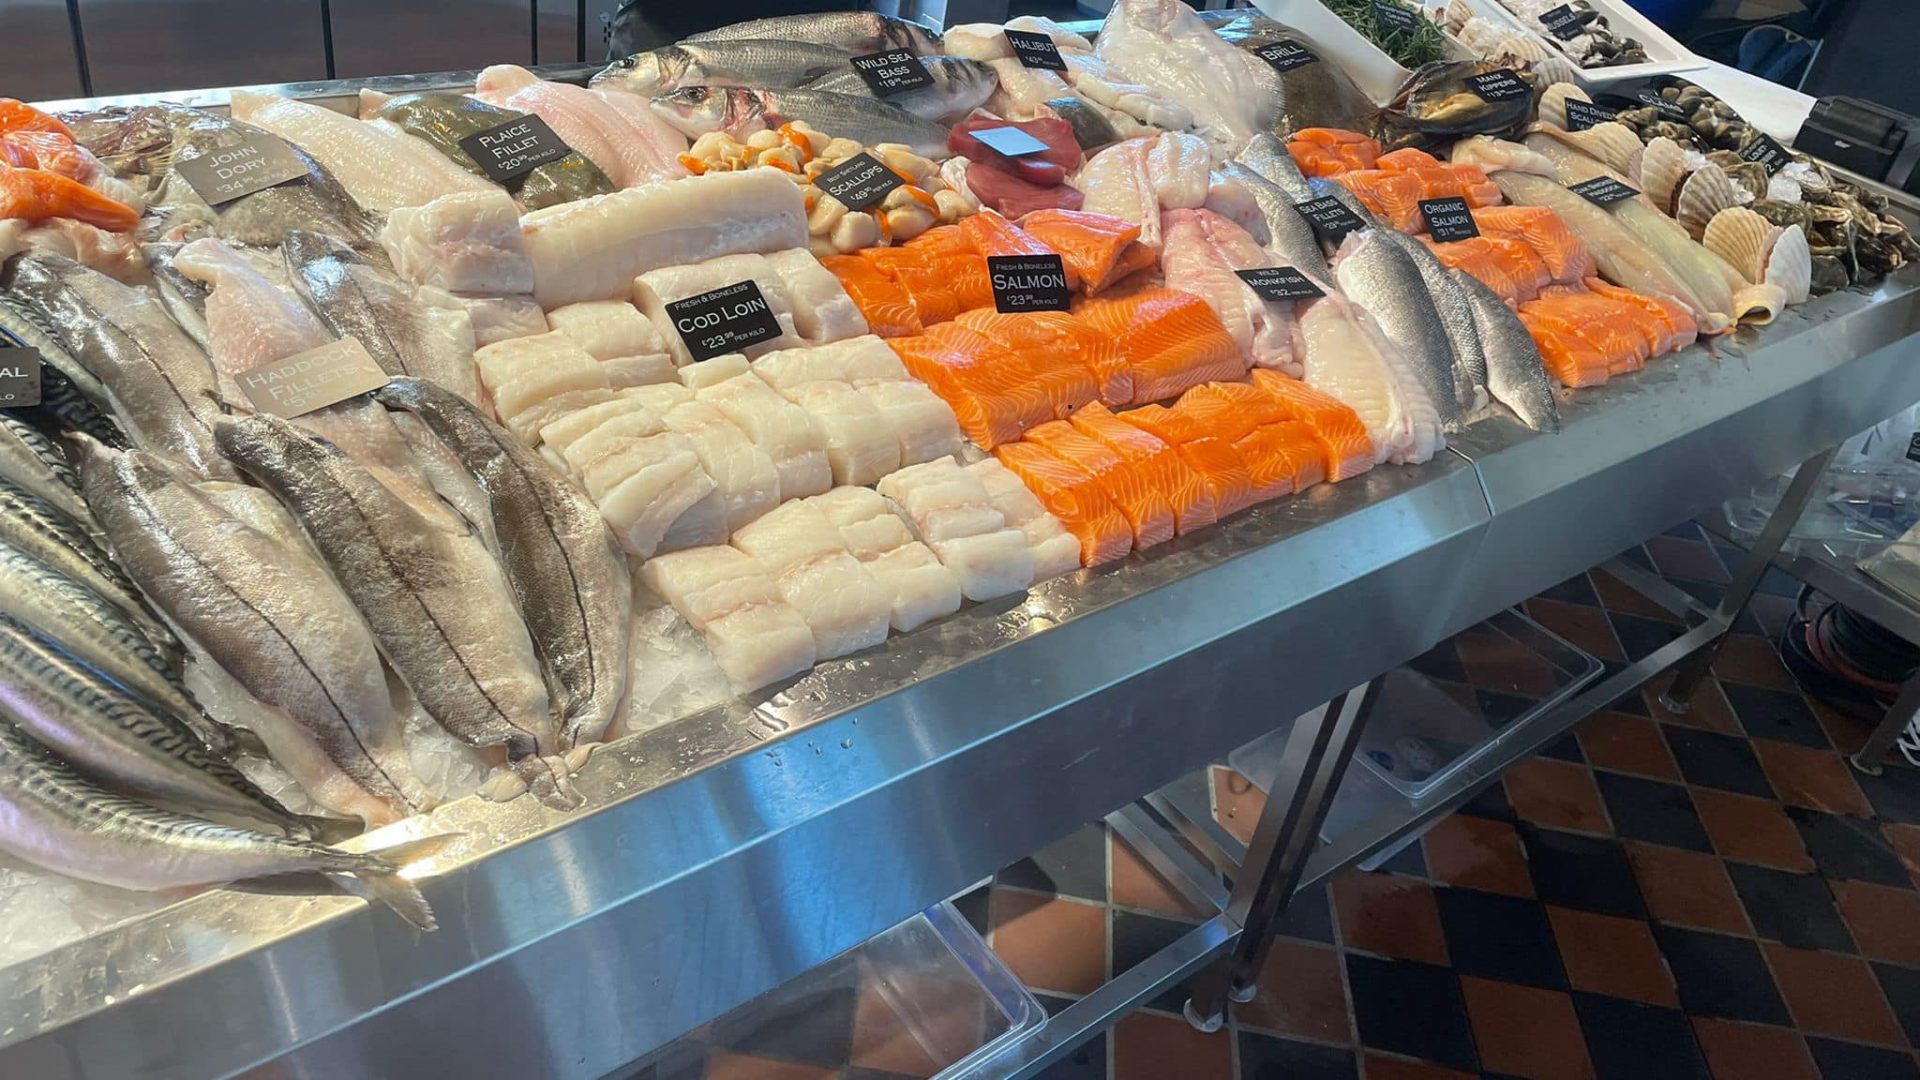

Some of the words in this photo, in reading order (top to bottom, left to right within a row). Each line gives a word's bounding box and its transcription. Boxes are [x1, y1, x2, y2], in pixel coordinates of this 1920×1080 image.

[1548, 12, 1576, 30] USSELS
[1009, 36, 1056, 52] HALIBUT
[855, 57, 889, 70] WILD
[887, 52, 914, 64] SEA
[1260, 45, 1305, 61] BRILL
[877, 65, 911, 79] BASS
[1478, 78, 1518, 92] KIPPERS
[478, 123, 532, 148] PLAICE
[491, 135, 540, 159] FILLET
[209, 146, 258, 168] JOHN
[216, 157, 267, 180] DORY
[829, 165, 884, 196] SCALLOPS
[1299, 204, 1319, 214] SEA
[1314, 199, 1338, 210] BASS
[1424, 202, 1465, 215] ORGANIC
[1312, 208, 1346, 222] FILLETS
[1431, 215, 1469, 227] SALMON
[996, 263, 1017, 271] FRESH
[1023, 262, 1057, 270] BONELESS
[1256, 269, 1280, 277] WILD
[993, 274, 1065, 290] SALMON
[1247, 276, 1306, 287] MONKFISH
[674, 299, 701, 311] FRESH
[701, 295, 708, 303] &
[707, 284, 749, 301] BONELESS
[678, 312, 721, 333] COD
[720, 298, 767, 321] LOIN
[734, 333, 749, 342] PER
[748, 327, 766, 338] KILO
[245, 344, 355, 389] HADDOCK
[269, 362, 359, 401] FILLETS
